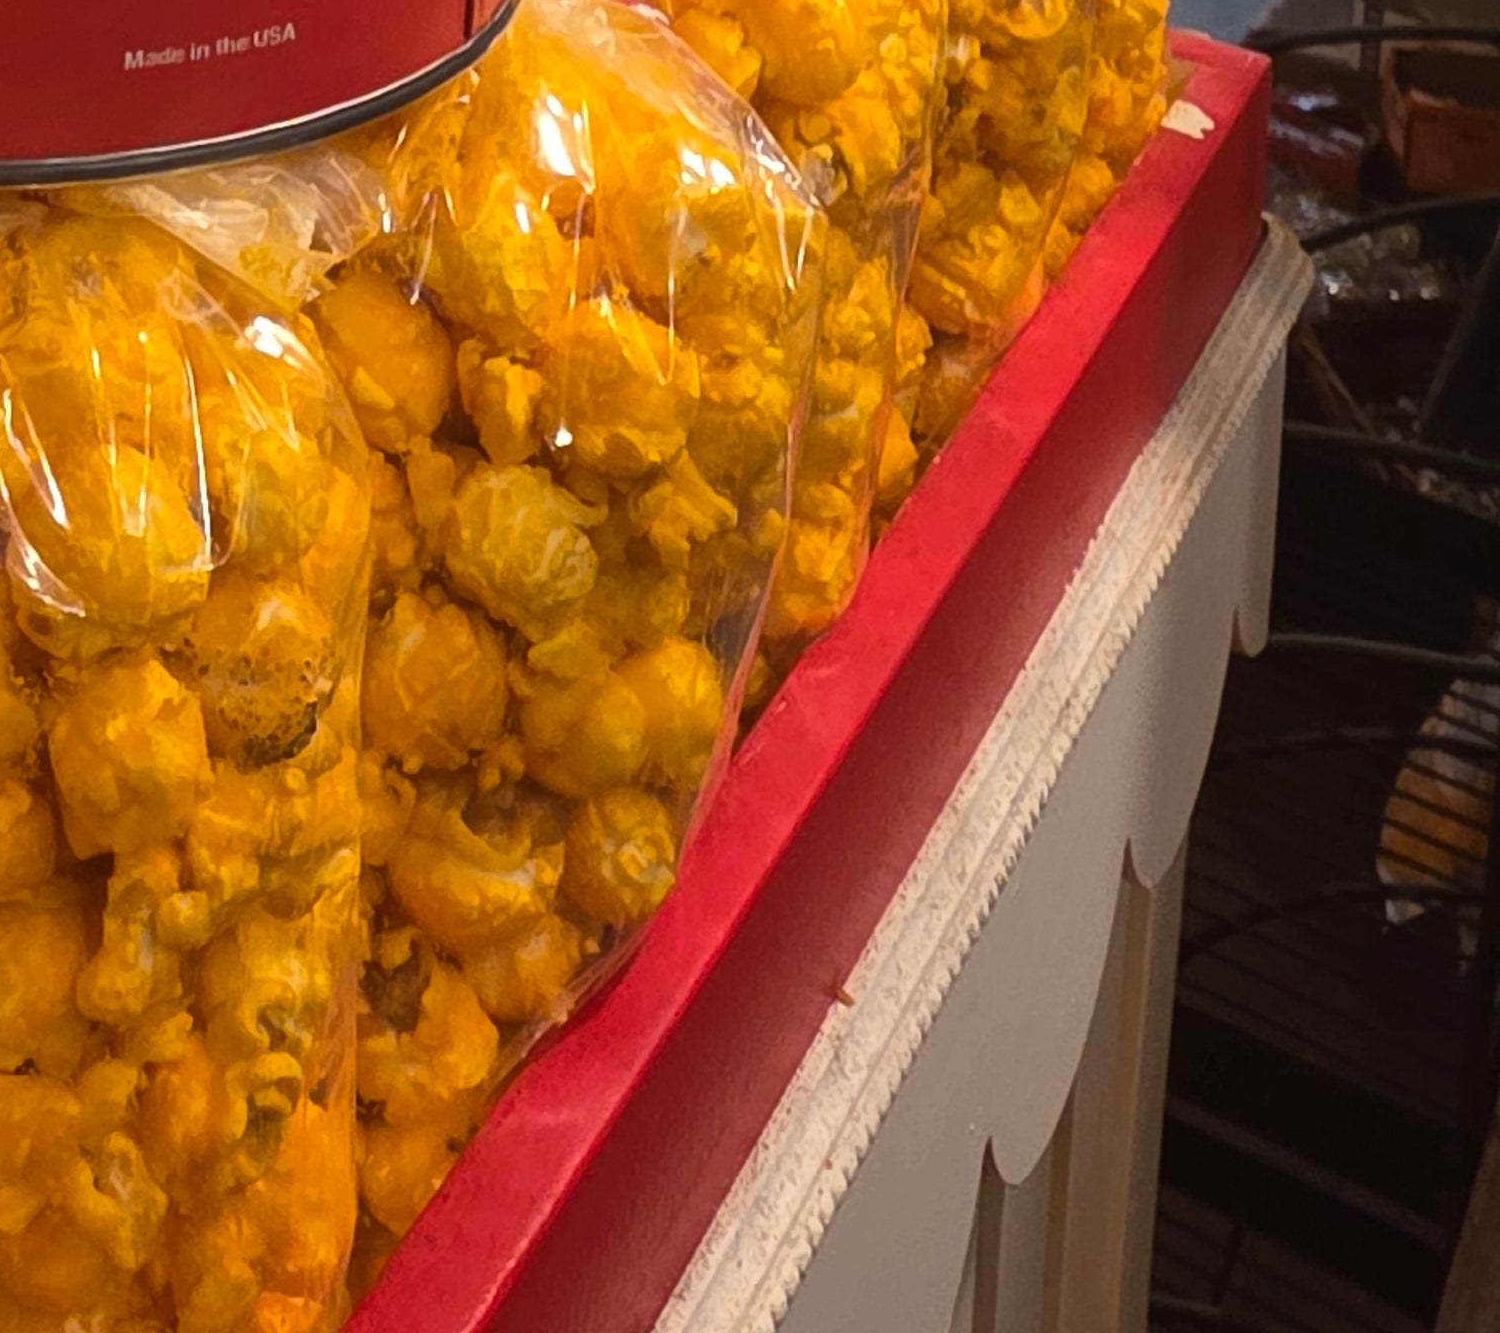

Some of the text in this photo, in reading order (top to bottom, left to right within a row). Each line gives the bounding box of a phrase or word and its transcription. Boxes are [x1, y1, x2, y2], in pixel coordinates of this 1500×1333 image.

[124, 22, 297, 70] Made in the USA
